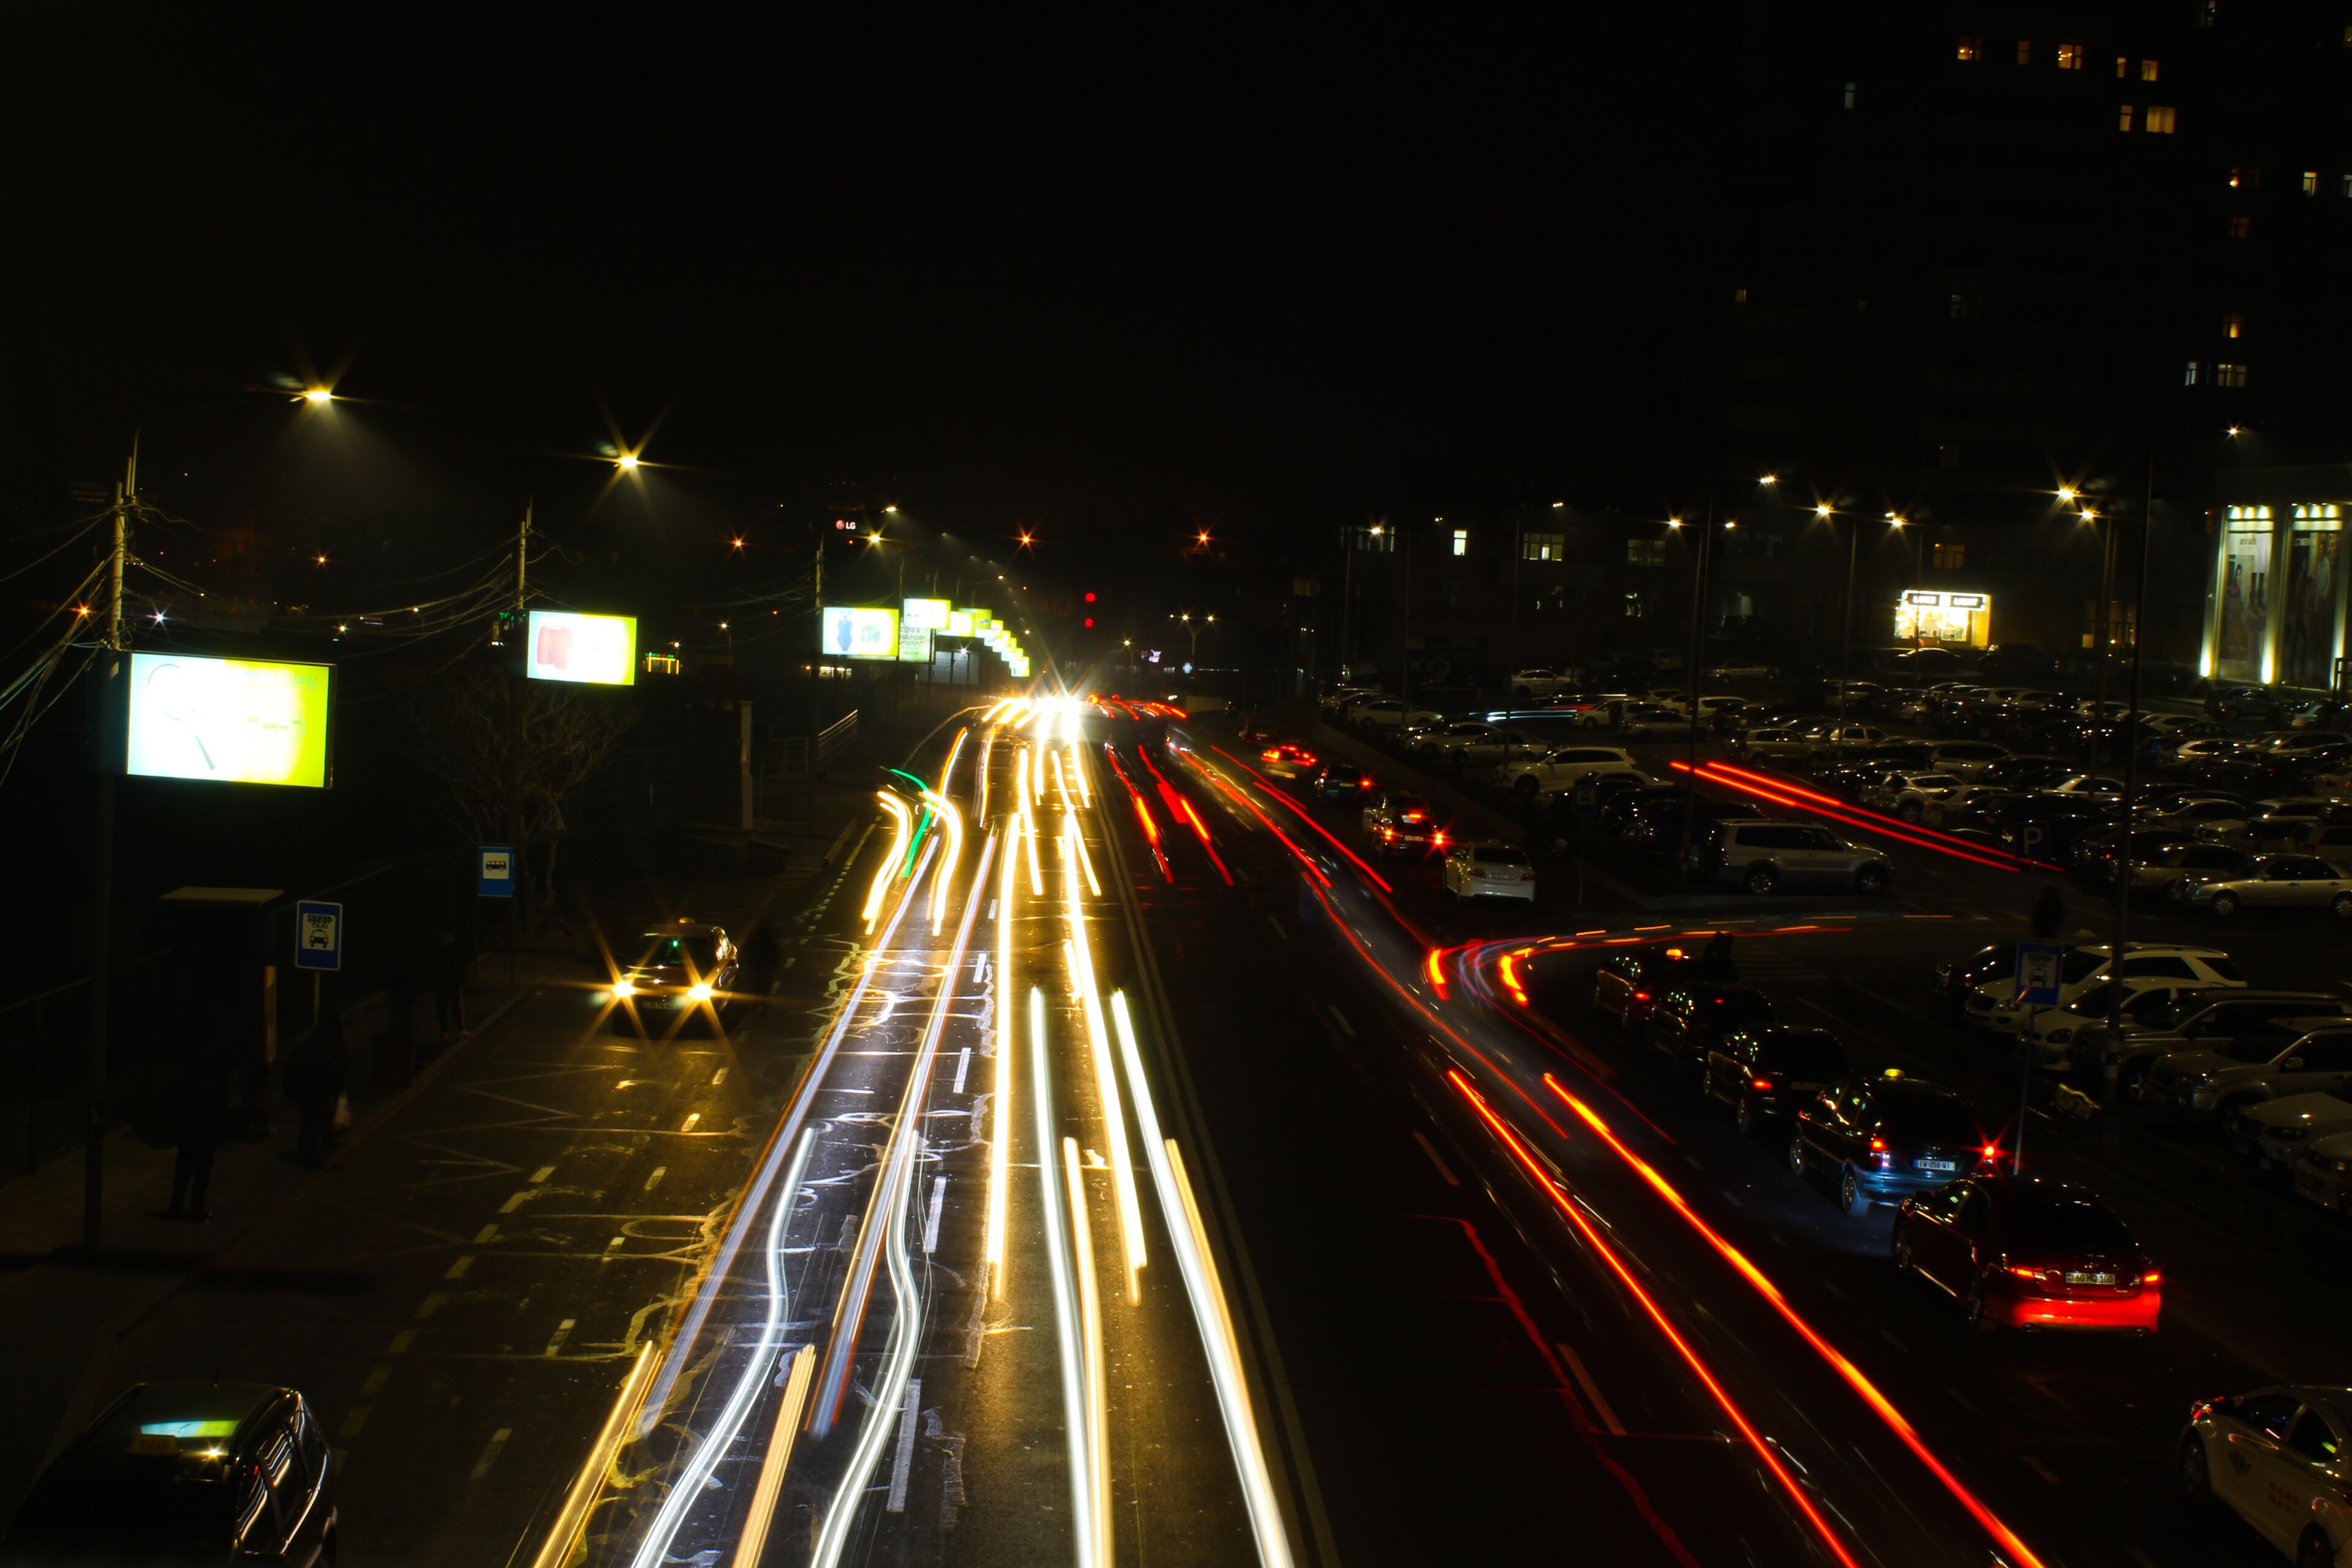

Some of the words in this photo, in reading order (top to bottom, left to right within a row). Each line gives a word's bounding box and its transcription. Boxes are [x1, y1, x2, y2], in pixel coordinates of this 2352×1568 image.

[2024, 826, 2043, 854] P
[2099, 1275, 2113, 1283] 100
[138, 1441, 167, 1452] TAXI
